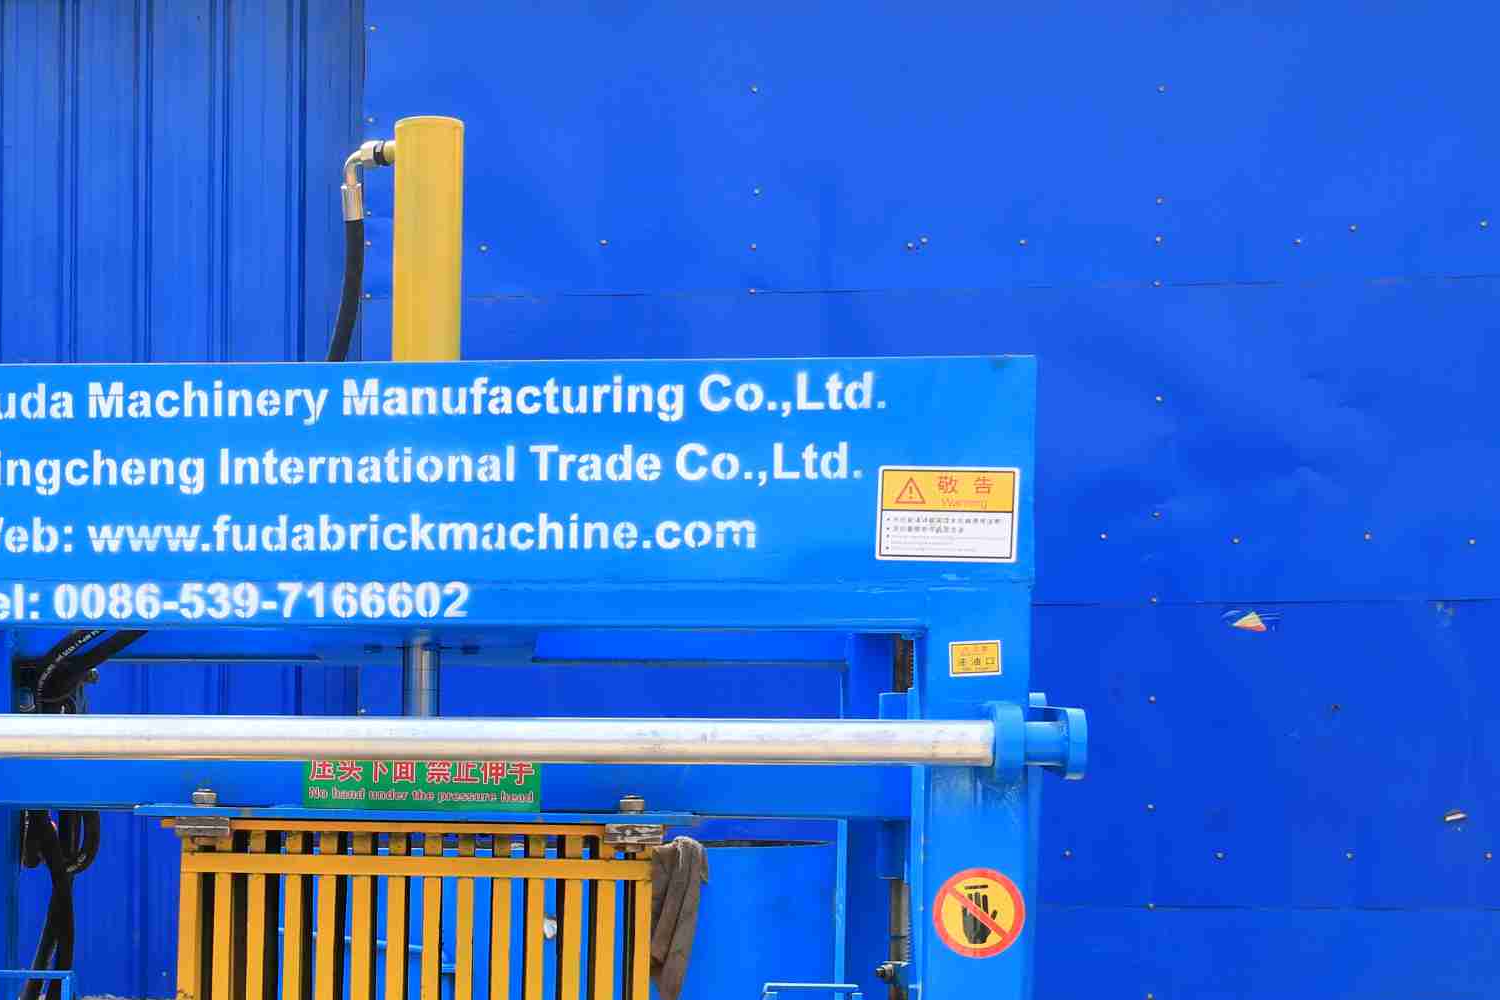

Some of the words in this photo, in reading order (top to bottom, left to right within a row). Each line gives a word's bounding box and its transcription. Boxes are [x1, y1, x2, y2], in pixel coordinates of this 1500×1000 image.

[88, 380, 329, 425] Machinery
[342, 375, 685, 422] Manufacturing
[699, 371, 887, 417] Co.,Ltd.
[219, 445, 515, 486] International
[529, 443, 661, 483] Trade
[675, 441, 862, 487] Co.,Ltd.
[938, 475, 994, 494] 敬告
[87, 512, 756, 553] www.fudabrickmachine.com
[54, 581, 470, 620] 0086-539-7166602
[308, 786, 328, 799] No
[332, 787, 365, 800] hand
[369, 789, 408, 801] under
[412, 789, 435, 801] the
[438, 791, 497, 803] pressure
